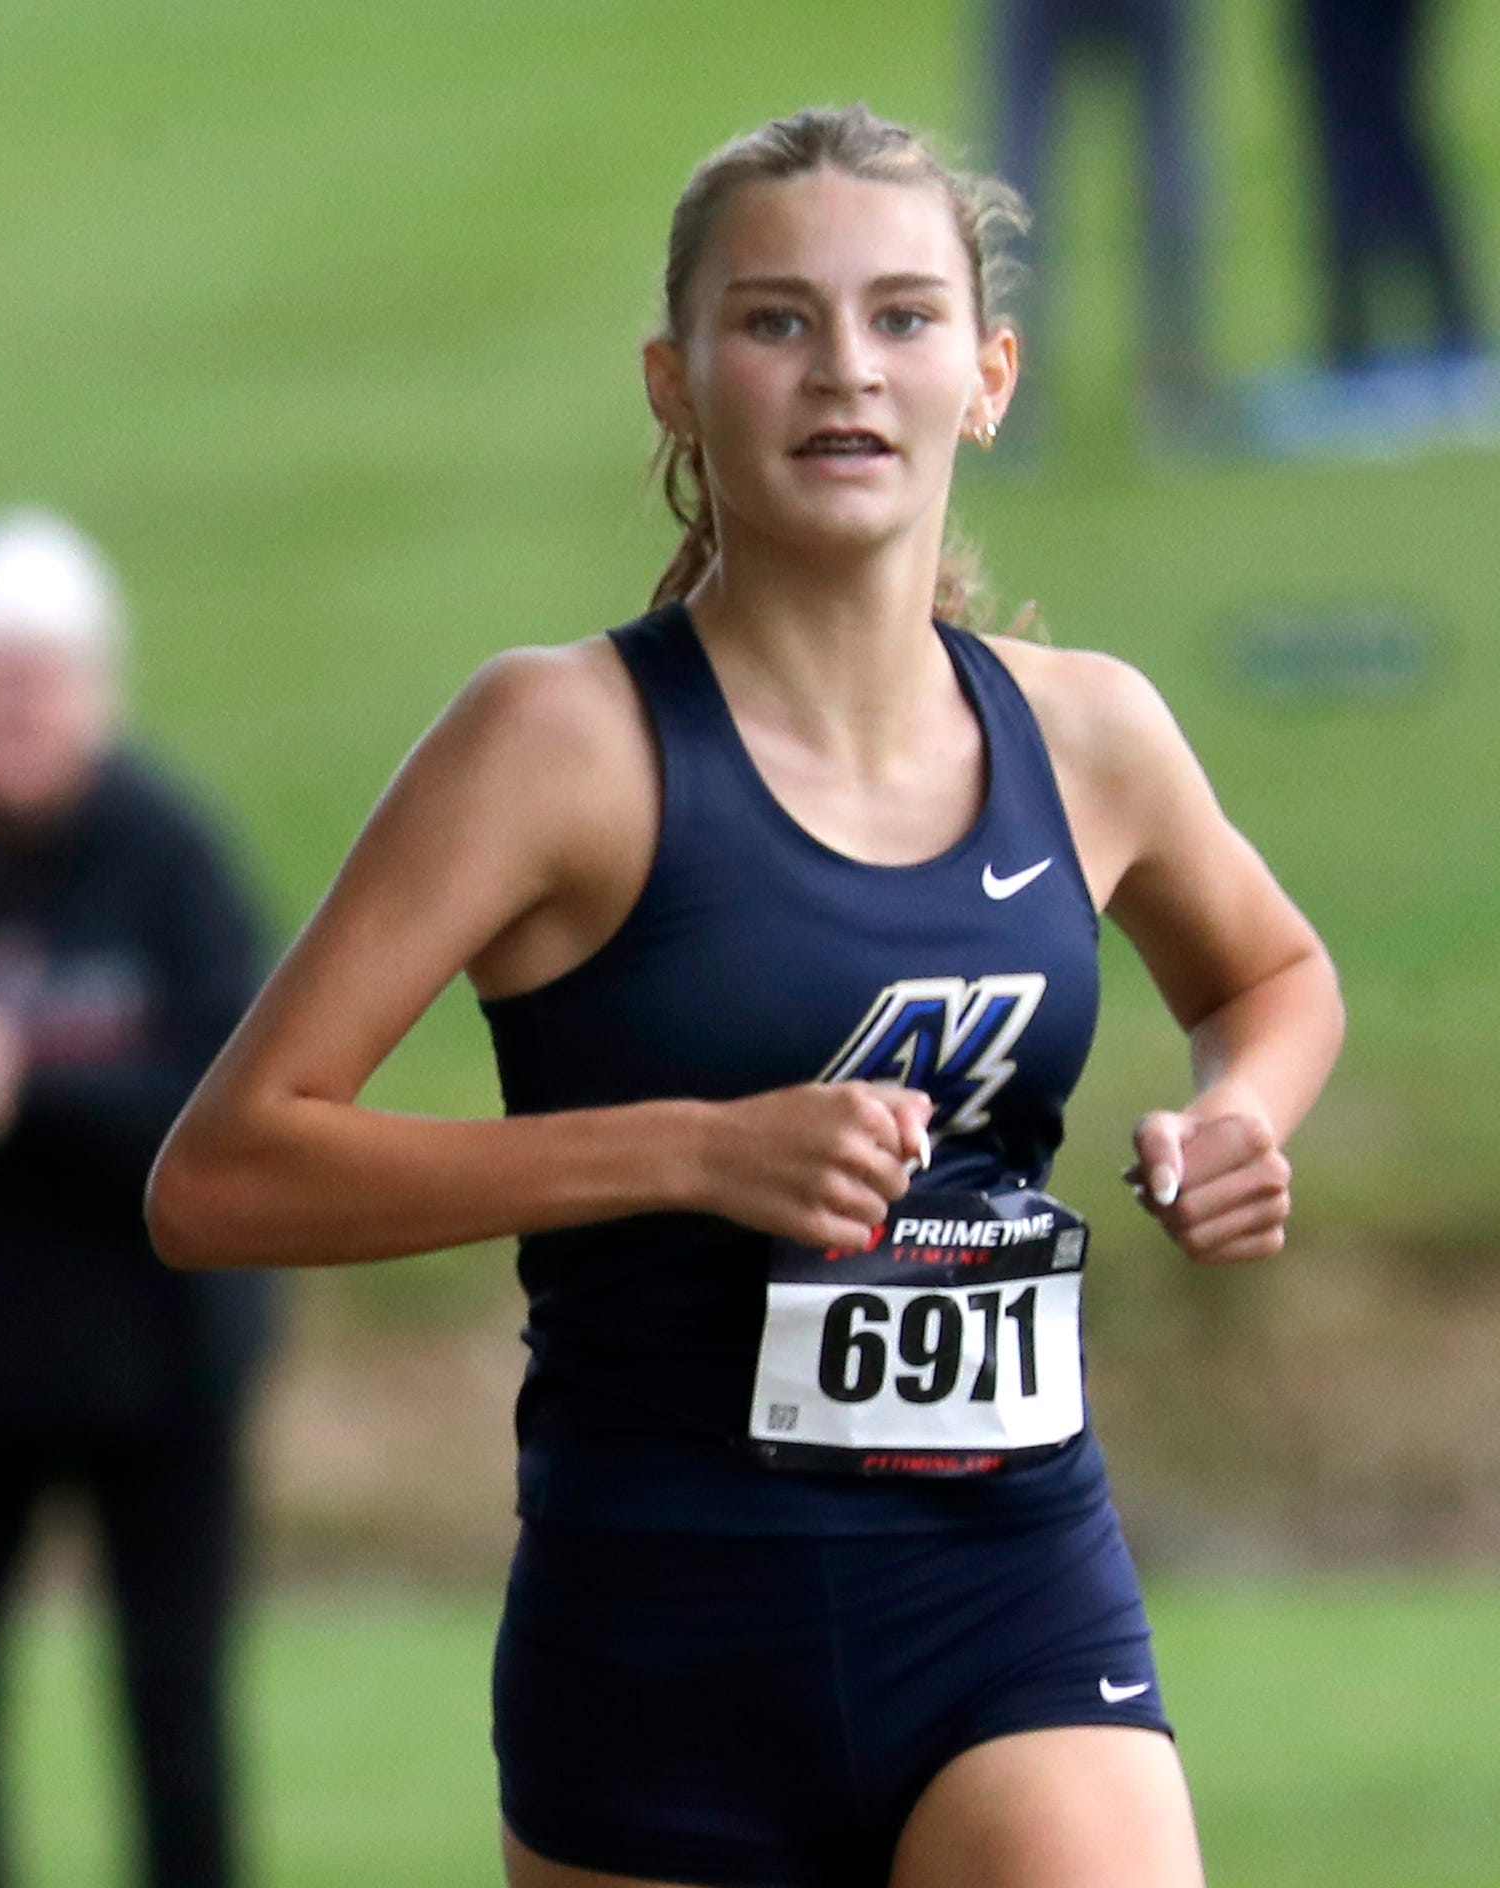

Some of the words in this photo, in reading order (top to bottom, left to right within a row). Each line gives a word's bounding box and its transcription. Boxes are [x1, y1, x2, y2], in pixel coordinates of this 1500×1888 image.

[892, 1212, 1054, 1248] PRIMETIME
[893, 1247, 991, 1265] TIMING
[819, 1286, 1038, 1403] 6971
